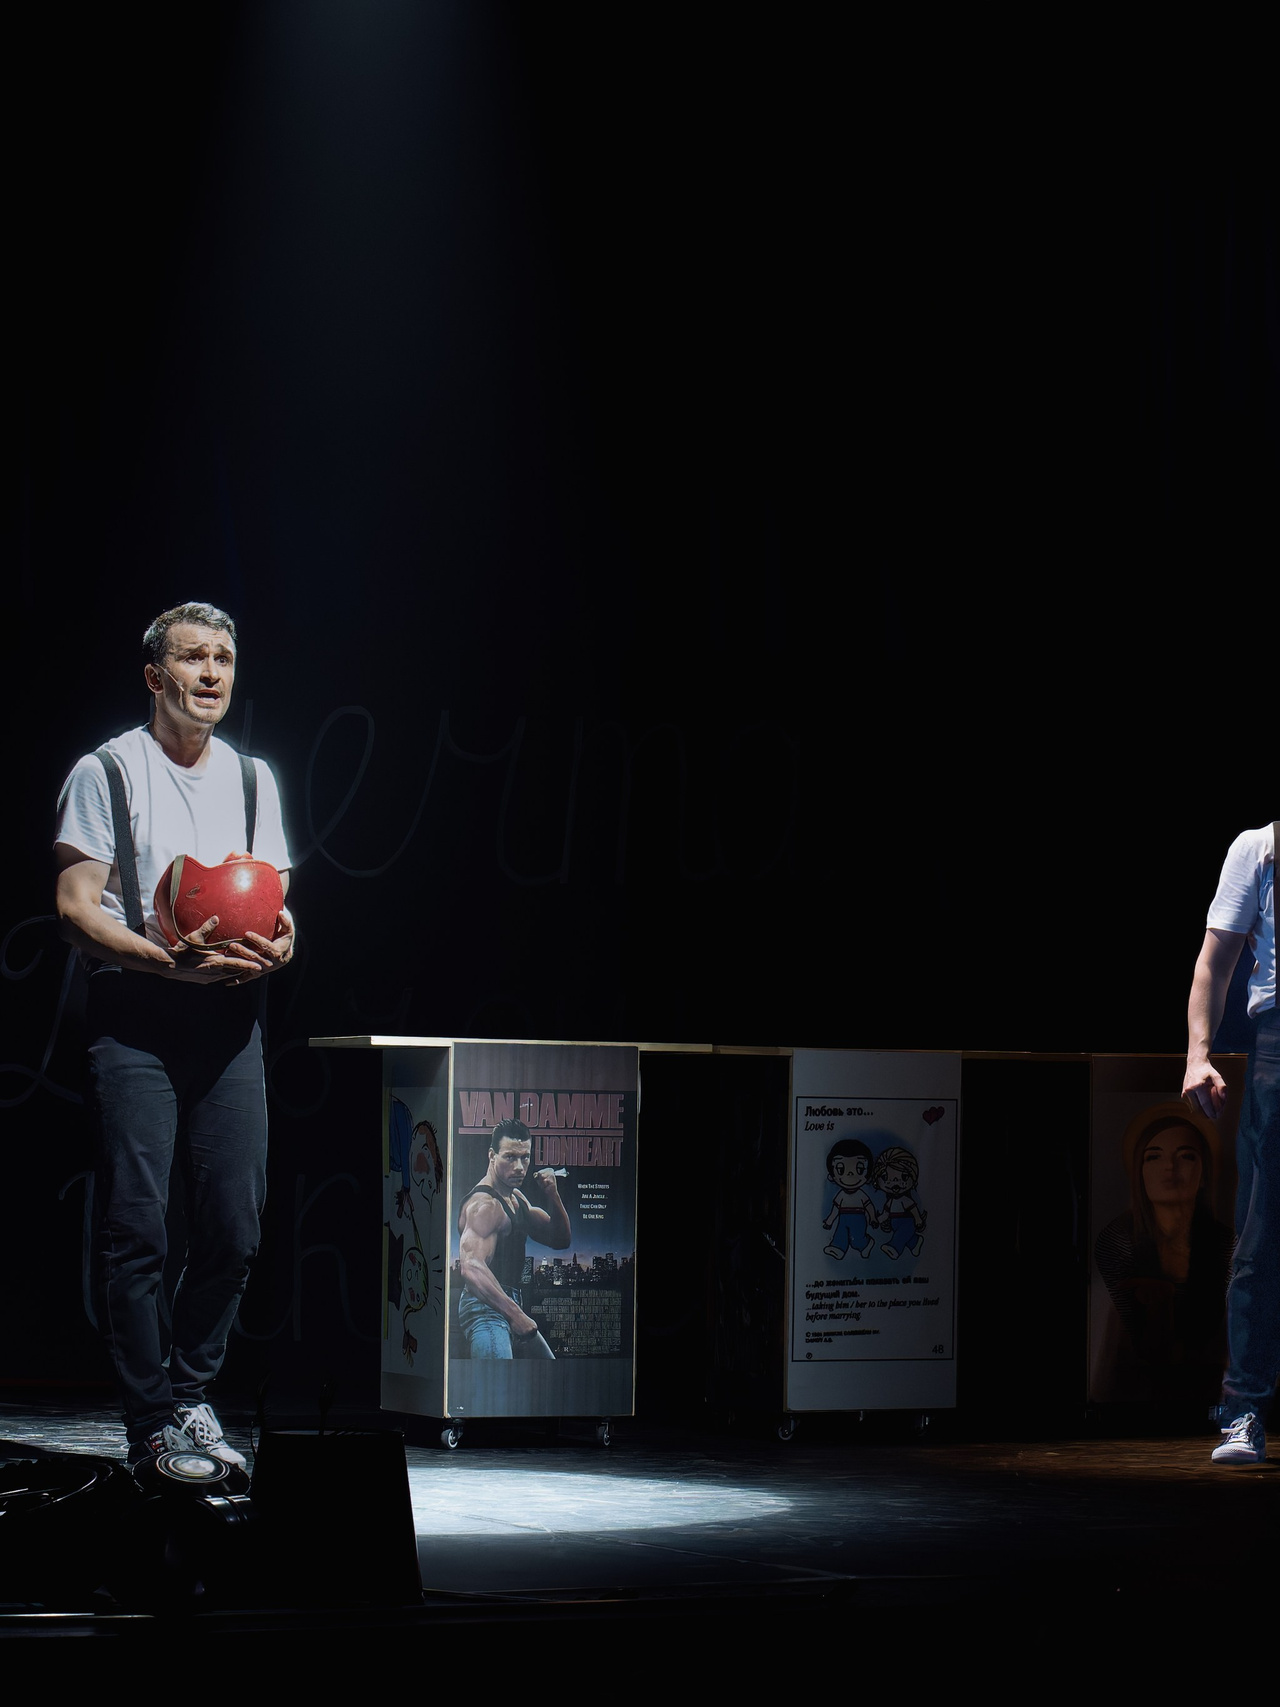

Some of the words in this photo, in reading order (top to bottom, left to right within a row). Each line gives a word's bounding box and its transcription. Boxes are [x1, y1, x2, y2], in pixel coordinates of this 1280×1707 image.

[459, 1091, 514, 1127] VAN
[519, 1092, 625, 1129] DAMME
[805, 1105, 844, 1116] Любовь
[846, 1107, 874, 1116] это...
[804, 1120, 825, 1131] Love
[826, 1120, 835, 1131] is
[534, 1136, 623, 1167] LIONHEART
[805, 1290, 840, 1301] будущий
[841, 1290, 860, 1299] дом.
[835, 1301, 849, 1309] him
[855, 1300, 867, 1308] her
[868, 1300, 876, 1308] to
[877, 1299, 887, 1307] the
[887, 1298, 907, 1310] place
[906, 1300, 922, 1309] you
[922, 1297, 940, 1306] lived
[805, 1312, 828, 1323] before
[931, 1344, 944, 1354] 48
